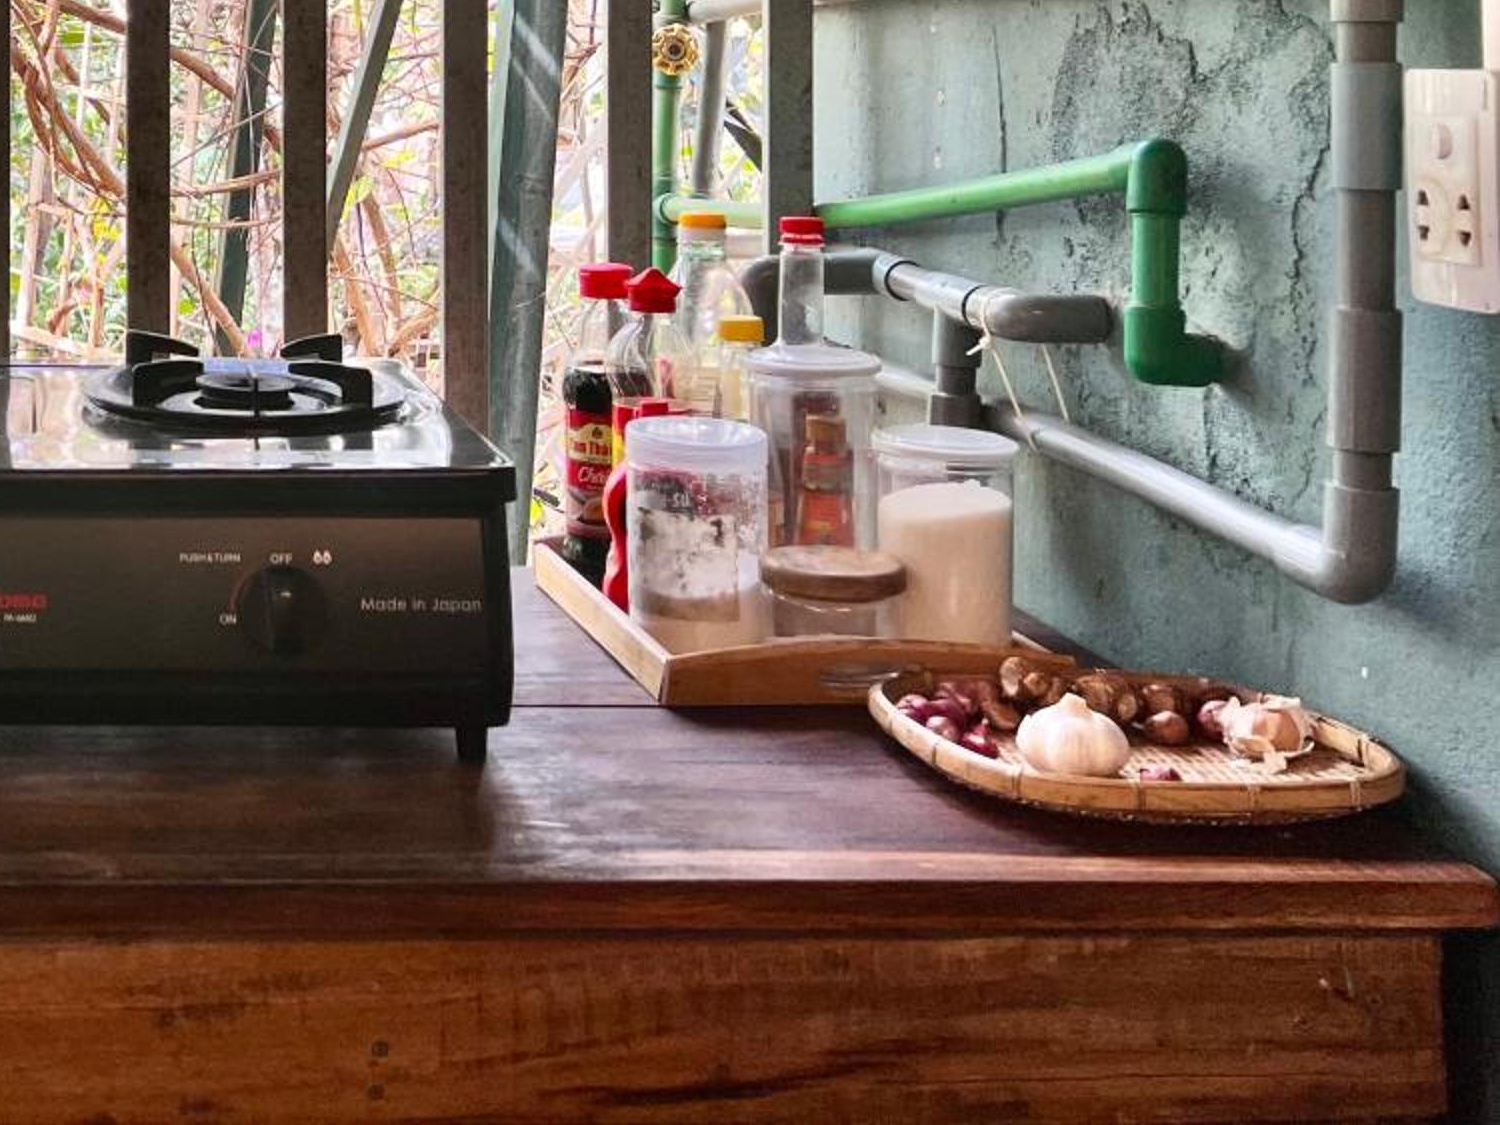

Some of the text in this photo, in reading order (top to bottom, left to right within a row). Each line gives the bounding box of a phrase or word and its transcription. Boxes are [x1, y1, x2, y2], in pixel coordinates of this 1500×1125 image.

[269, 553, 293, 565] OFF
[361, 596, 482, 614] Made in Japan
[219, 613, 237, 625] ON
